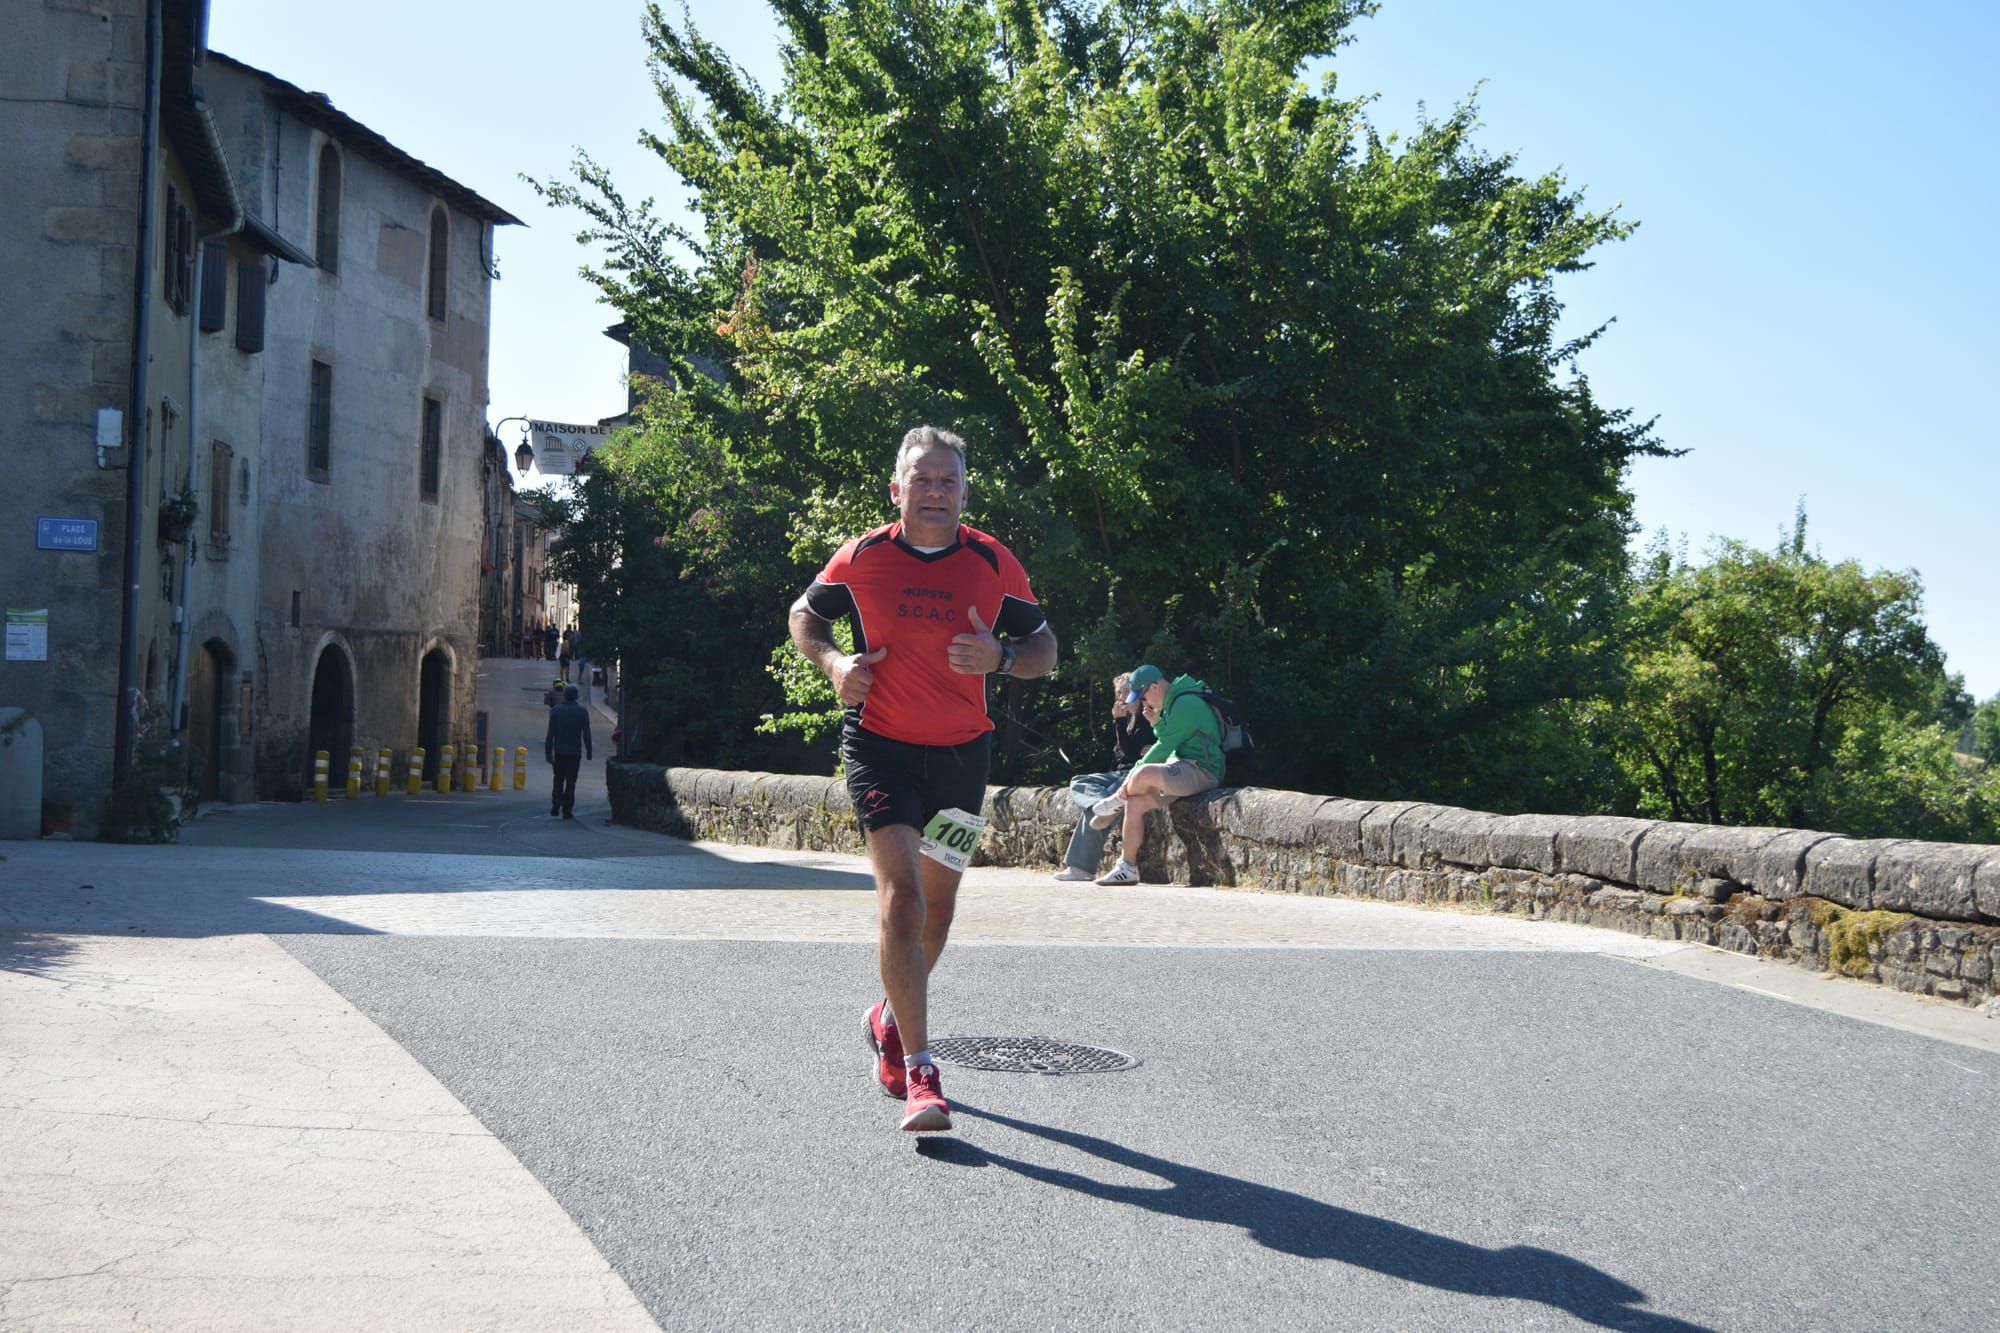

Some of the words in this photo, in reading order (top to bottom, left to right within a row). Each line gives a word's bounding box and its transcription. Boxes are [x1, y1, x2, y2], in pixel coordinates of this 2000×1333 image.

[534, 423, 586, 435] MAISON
[590, 426, 607, 435] DE
[61, 524, 86, 534] PLACE
[73, 536, 93, 545] LOUE
[936, 822, 977, 853] 108
